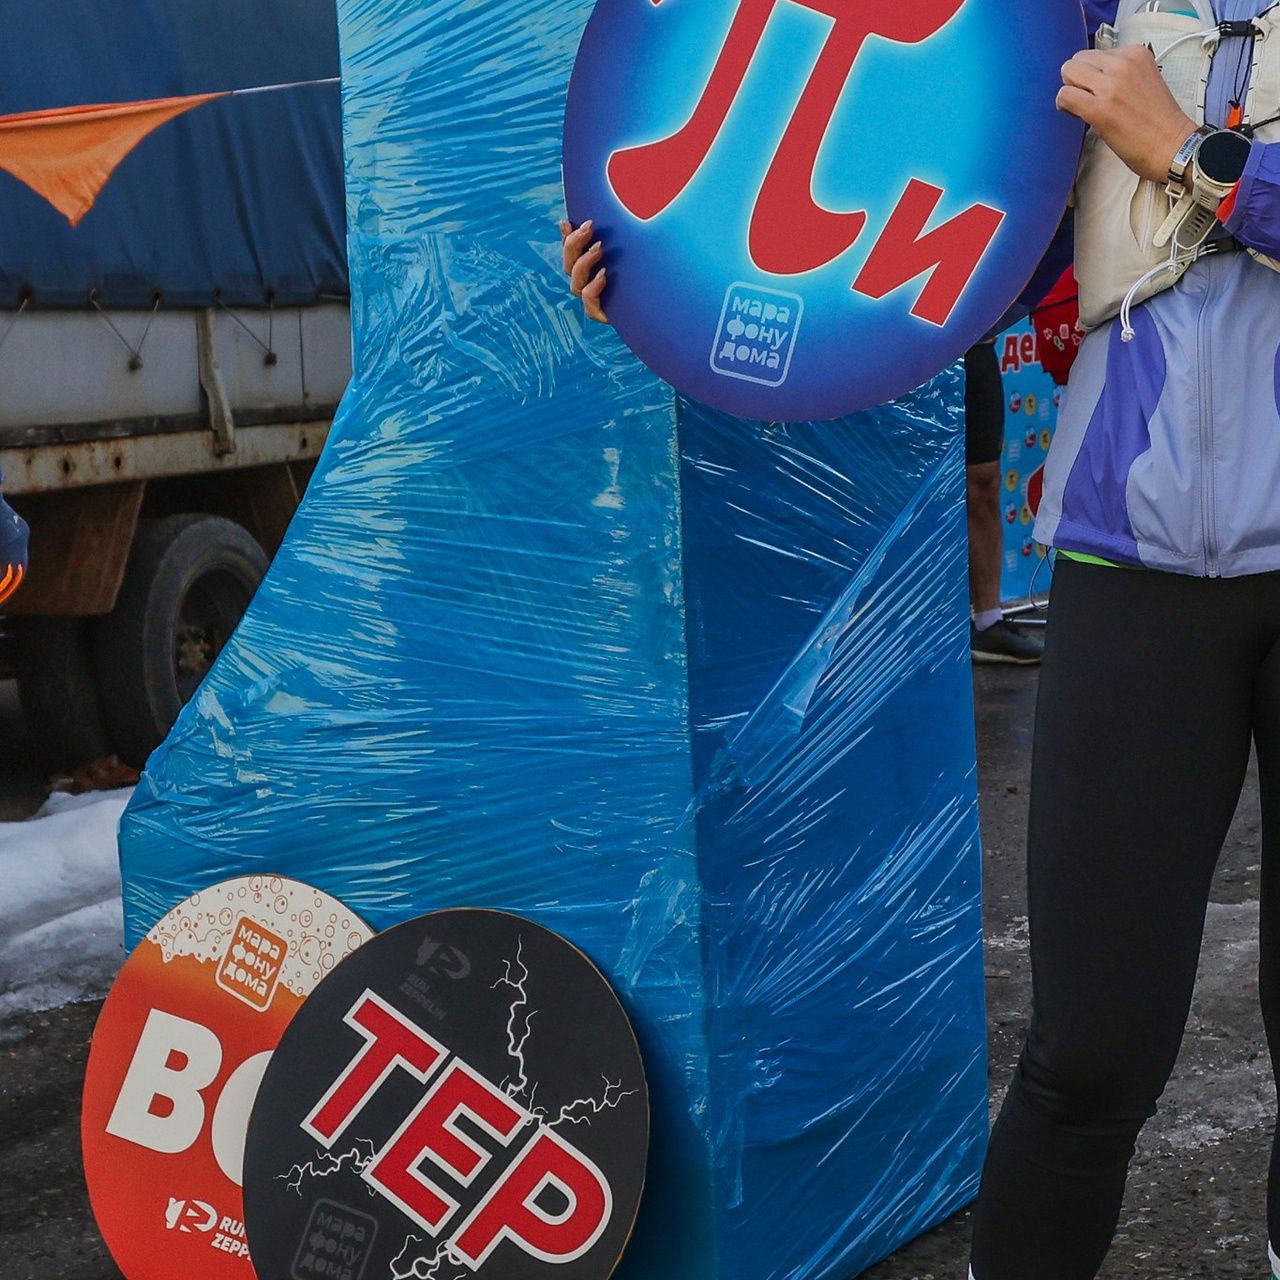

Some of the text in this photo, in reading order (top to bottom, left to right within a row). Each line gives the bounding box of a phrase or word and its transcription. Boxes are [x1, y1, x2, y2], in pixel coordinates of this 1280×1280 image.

[732, 296, 790, 324] мара
[726, 314, 789, 350] фону
[719, 341, 780, 369] дома
[238, 925, 280, 960] мара
[232, 941, 277, 980] фону
[223, 961, 268, 997] дома
[300, 988, 612, 1271] ТЕР
[316, 1211, 366, 1242] мара
[211, 1232, 251, 1261] ZEPP
[309, 1230, 362, 1266] фону
